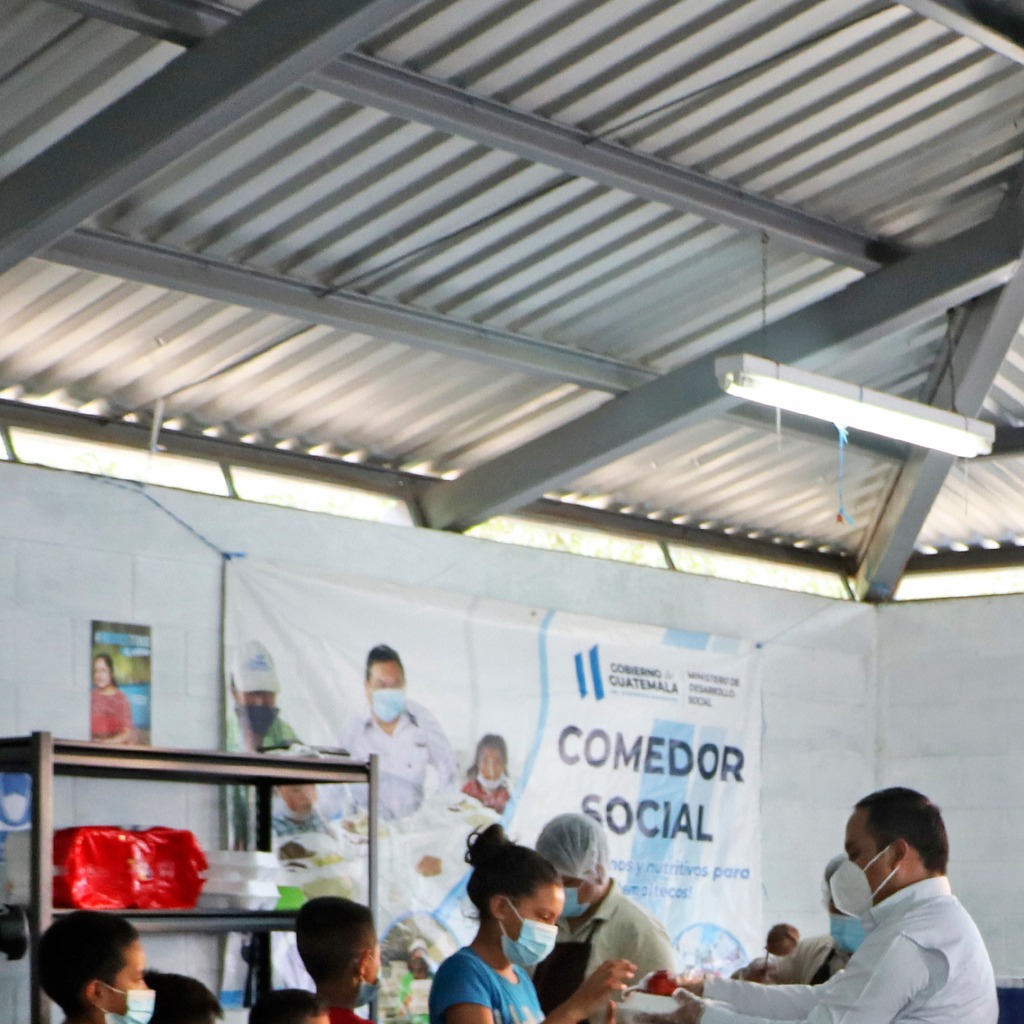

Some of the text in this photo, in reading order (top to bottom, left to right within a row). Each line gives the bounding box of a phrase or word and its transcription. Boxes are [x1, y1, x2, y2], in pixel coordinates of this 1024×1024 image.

[610, 663, 661, 679] GOBIERNO
[609, 675, 678, 693] GUATEMALA
[558, 725, 745, 783] COMEDOR
[581, 794, 713, 842] SOCIAL
[646, 860, 709, 878] nutritivos
[712, 866, 751, 882] para
